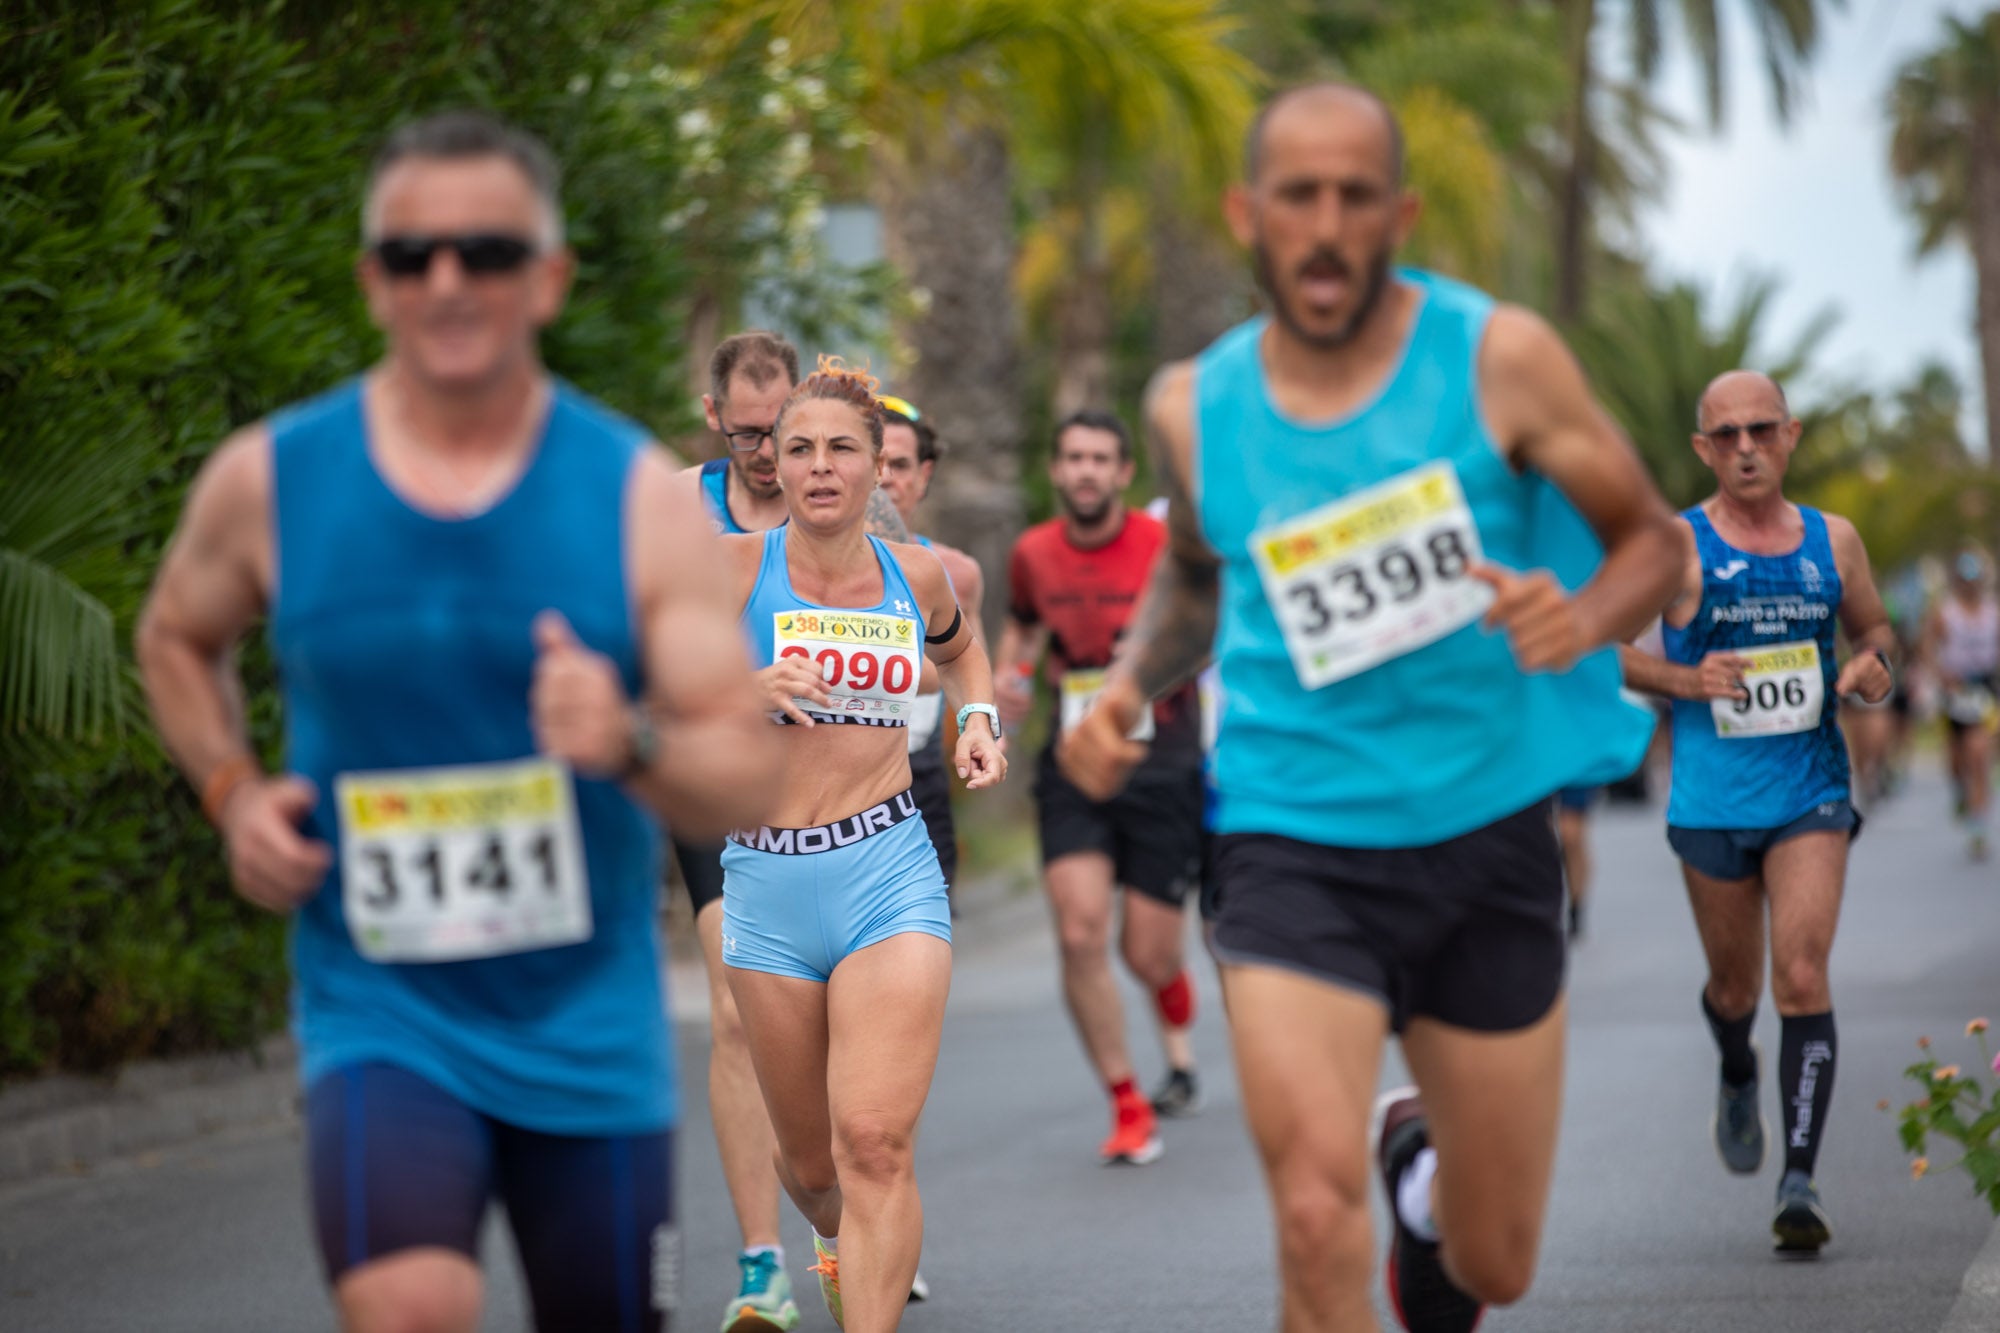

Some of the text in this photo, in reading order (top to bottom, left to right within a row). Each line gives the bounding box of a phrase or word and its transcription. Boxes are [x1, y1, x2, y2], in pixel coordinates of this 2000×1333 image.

[1286, 528, 1469, 637] 3398
[1777, 602, 1829, 620] PAZITO
[796, 616, 819, 633] 38
[823, 615, 849, 624] GRAN
[850, 617, 885, 626] PREMIO
[820, 622, 890, 640] FONDO
[365, 832, 557, 908] 3141
